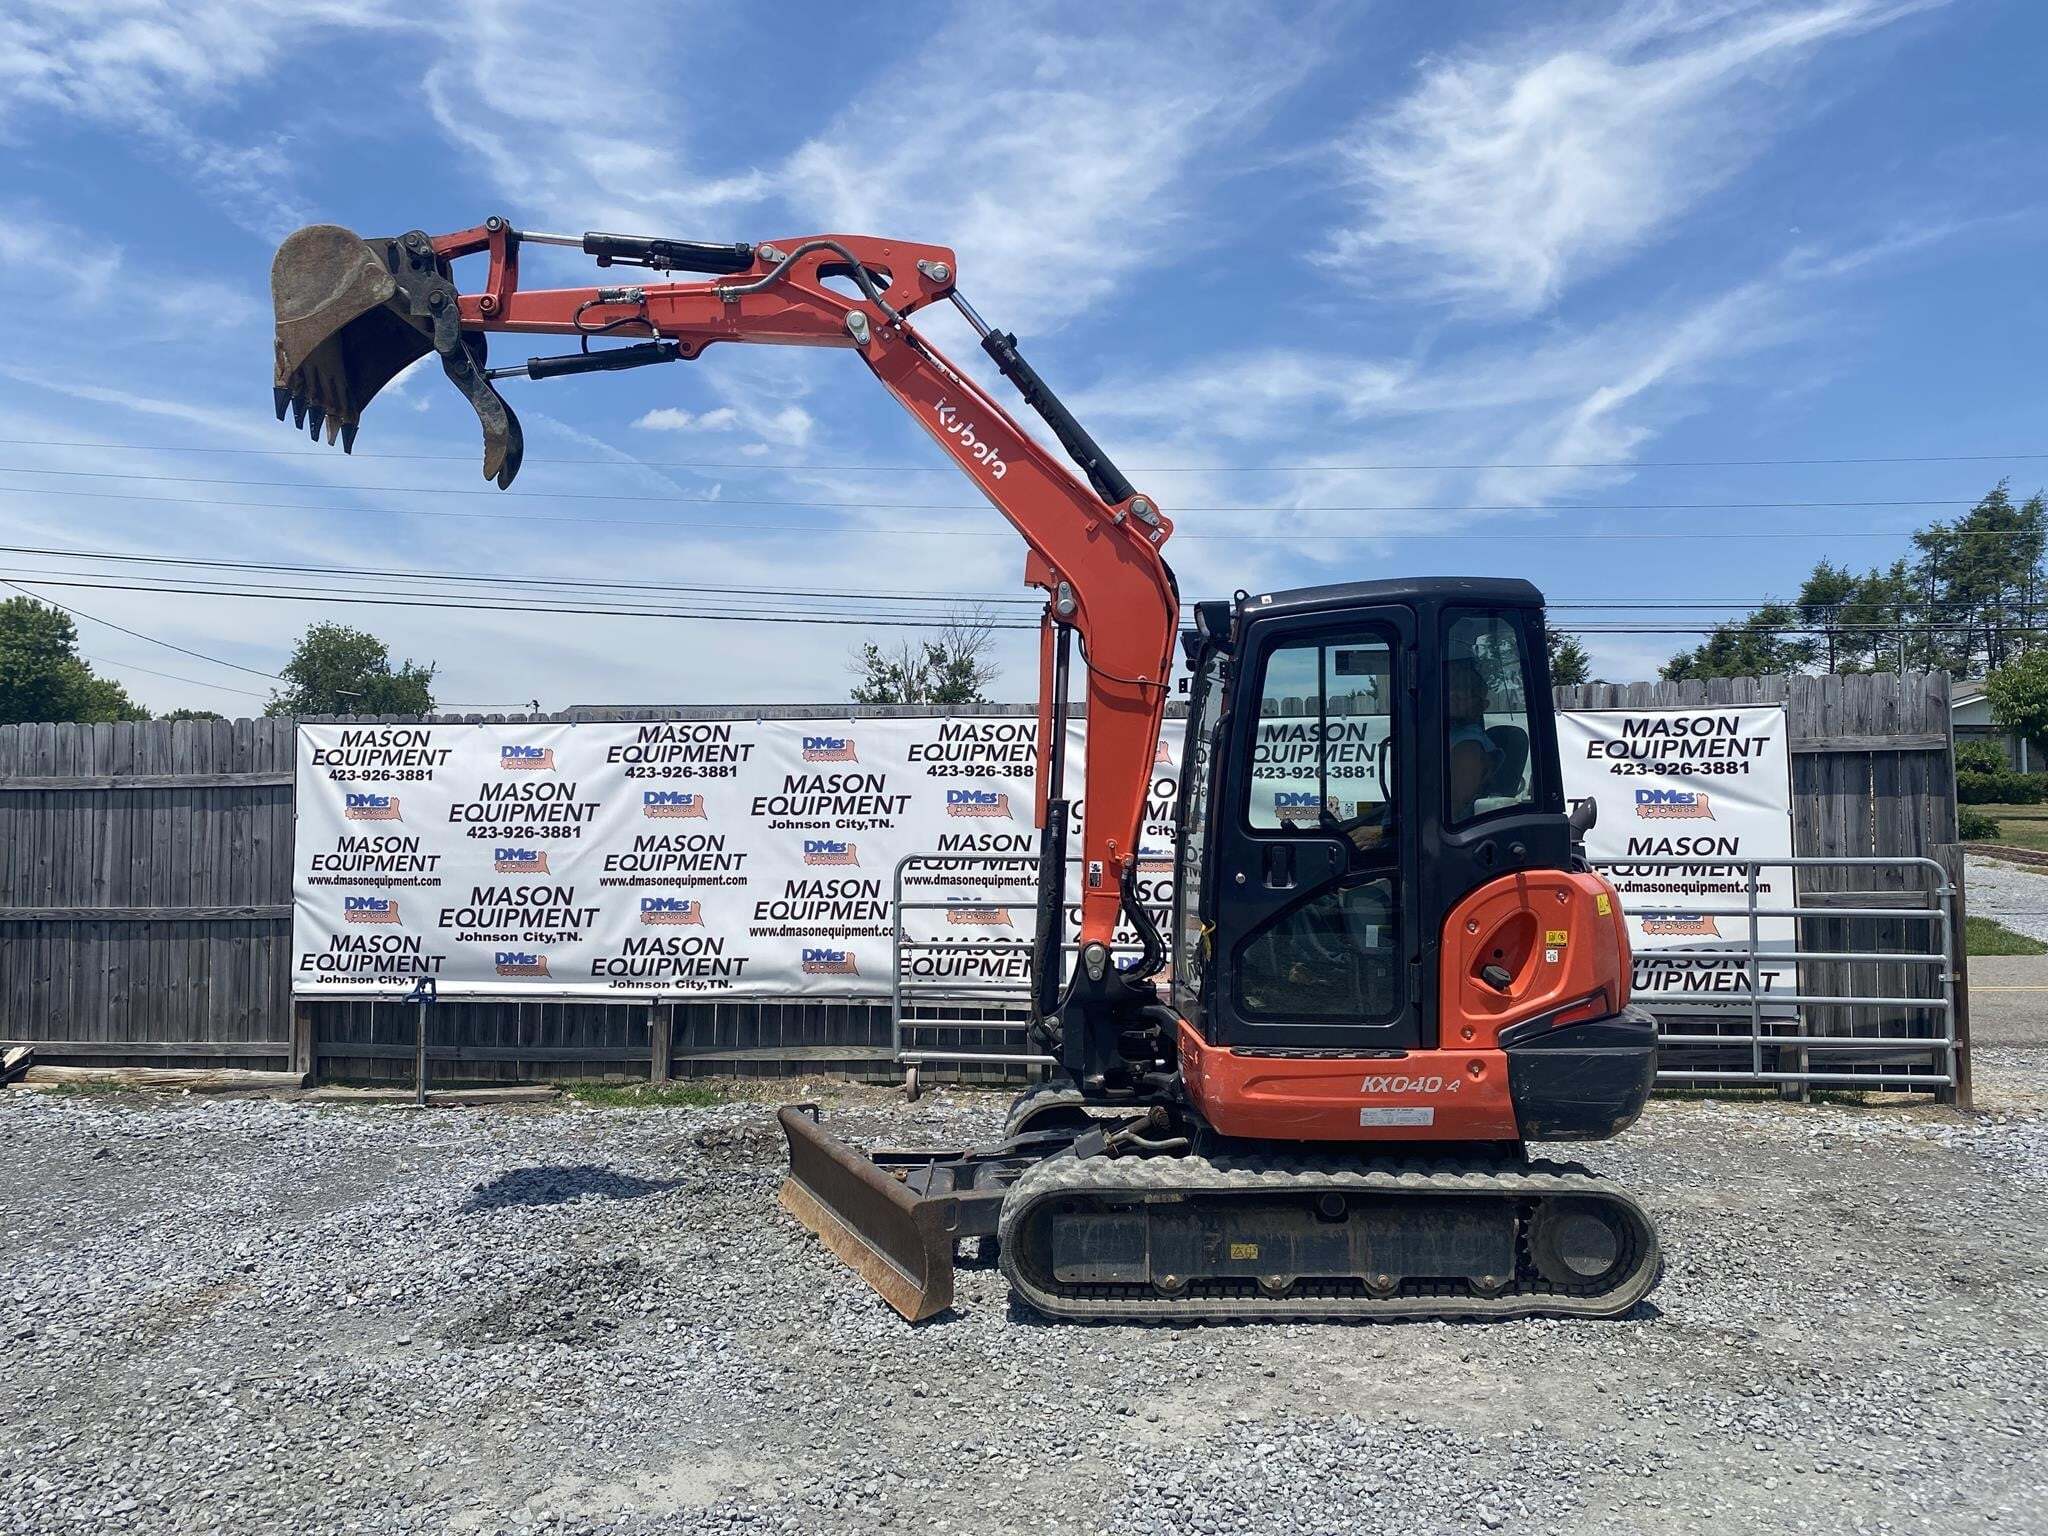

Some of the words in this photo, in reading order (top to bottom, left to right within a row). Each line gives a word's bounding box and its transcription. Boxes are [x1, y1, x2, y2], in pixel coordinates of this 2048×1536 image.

[934, 397, 1007, 480] Kubota
[637, 725, 732, 743] MASON
[938, 724, 1037, 743] MASON
[1264, 723, 1367, 743] MASON
[1622, 716, 1740, 738] MASON
[340, 730, 431, 748] MASON
[1587, 737, 1770, 759] EQUIPMENT
[312, 749, 452, 766] EQUIPMENT
[606, 744, 754, 764] EQUIPMENT
[907, 744, 1038, 762] EQUIPMEN
[1253, 743, 1378, 763] QUIPMEN
[329, 769, 434, 781] 423-926-3881
[625, 765, 737, 778] 423-926-3881
[926, 765, 1037, 778] 423-926-388
[1610, 761, 1750, 776] 423-926-3881
[479, 782, 576, 801] MASON
[783, 774, 885, 794] MASON
[449, 803, 600, 823] EQUIPMENT
[750, 795, 911, 816] EQUIPMENT
[467, 825, 581, 839] 423-926-3881
[768, 819, 831, 830] Johnson
[835, 819, 894, 831] City,TN.
[337, 836, 420, 854] MASON
[633, 834, 725, 853] MASON
[937, 834, 1032, 852] MASON
[1627, 837, 1739, 856] MASON
[311, 855, 441, 872] EQUIPMENT
[603, 853, 747, 872] EQUIPMENT
[908, 857, 1038, 871] EQUIPMEN
[308, 875, 441, 889] www.dmasonequipment.com
[600, 875, 747, 888] www.dmasonequipment.com
[784, 879, 881, 899] MASON
[904, 874, 1039, 888] www.dmasonequipment.c
[470, 886, 574, 906] MASON
[438, 908, 600, 928] EQUIPMENT
[753, 901, 894, 920] EQUIPMEN
[329, 935, 421, 953] MASON
[455, 932, 518, 943] Johnson
[522, 932, 583, 944] City,TN.
[622, 937, 724, 956] MASON
[300, 954, 446, 973] EQUIPMENT
[590, 957, 749, 977] EQUIPMENT
[316, 975, 374, 984] Johnson
[378, 975, 421, 987] City,T
[608, 980, 670, 989] Johnson
[1632, 971, 1780, 993] UIPMENT
